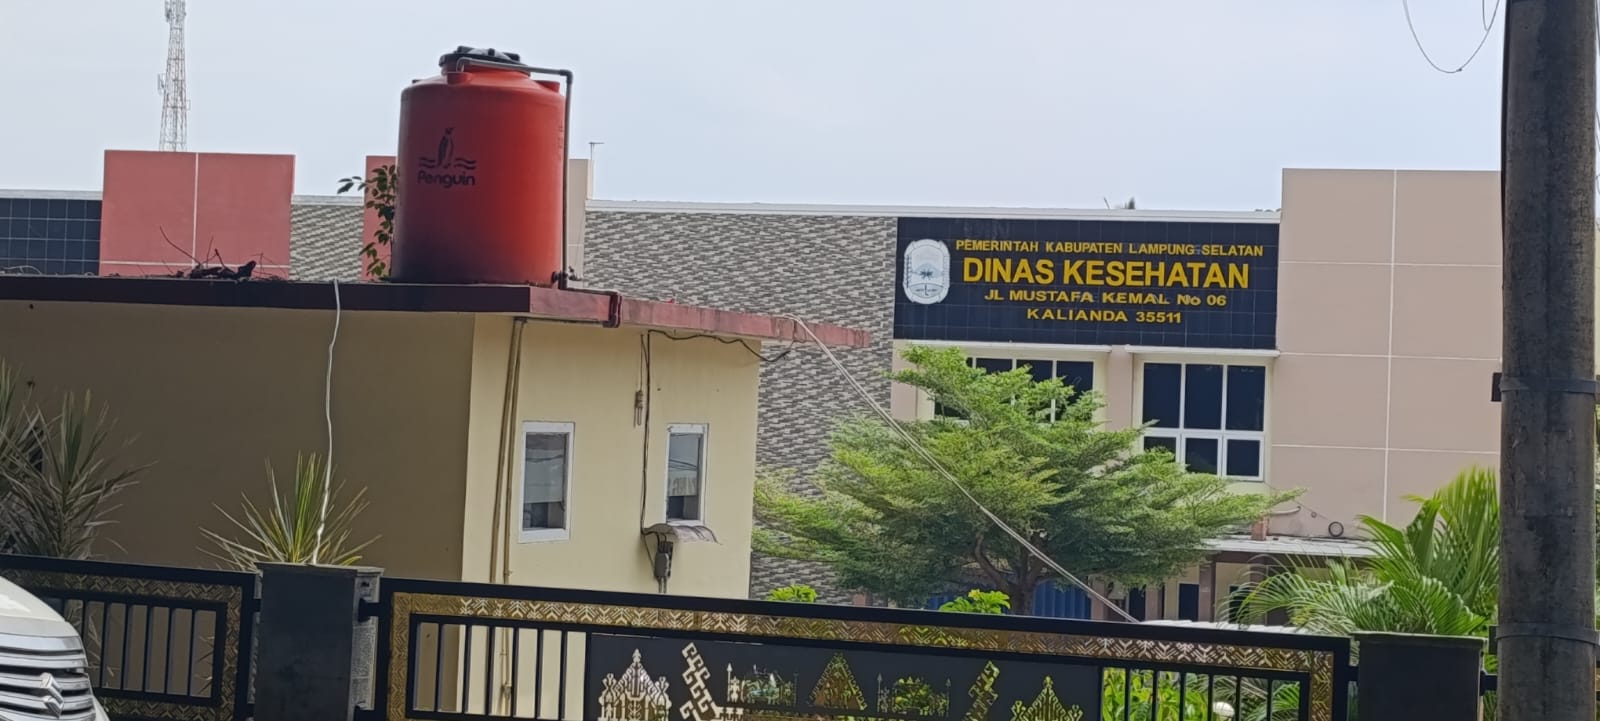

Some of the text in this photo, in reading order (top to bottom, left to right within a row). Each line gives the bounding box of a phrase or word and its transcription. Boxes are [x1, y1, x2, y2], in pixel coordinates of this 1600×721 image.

[417, 170, 476, 189] Penguin
[955, 240, 1264, 257] PEMERINTAH KABUPATEN LAMPUNG SELATAN
[962, 257, 1249, 289] DINAS KESEHATAN
[984, 289, 1227, 306] JL MUSTAFA KEMAL No 06
[1026, 308, 1182, 324] KALIANDA 35511
